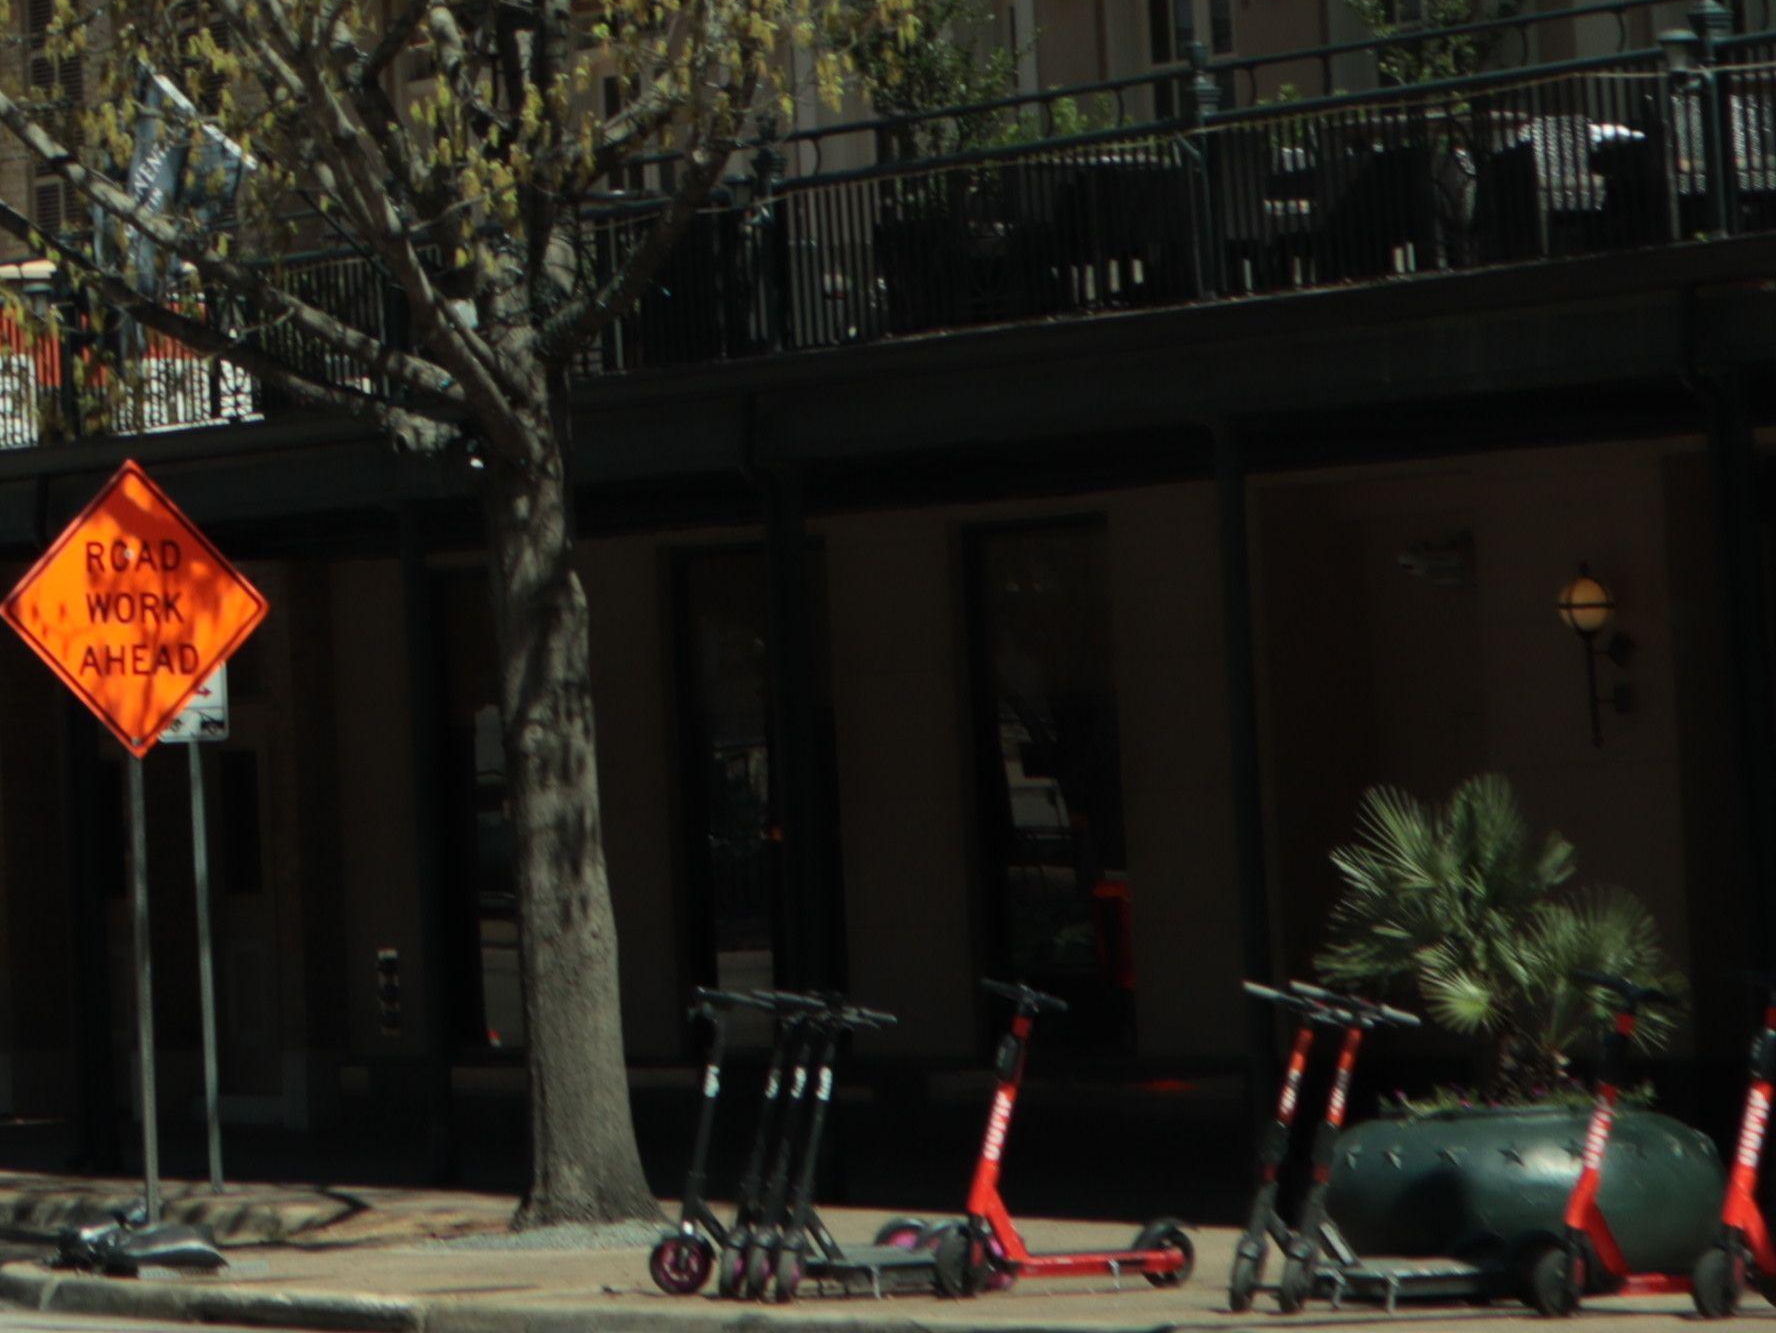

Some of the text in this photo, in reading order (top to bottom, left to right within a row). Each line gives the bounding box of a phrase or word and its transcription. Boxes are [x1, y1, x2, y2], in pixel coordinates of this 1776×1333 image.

[85, 540, 182, 574] ROAD
[87, 592, 186, 625] WORK
[79, 643, 200, 677] AHEAD
